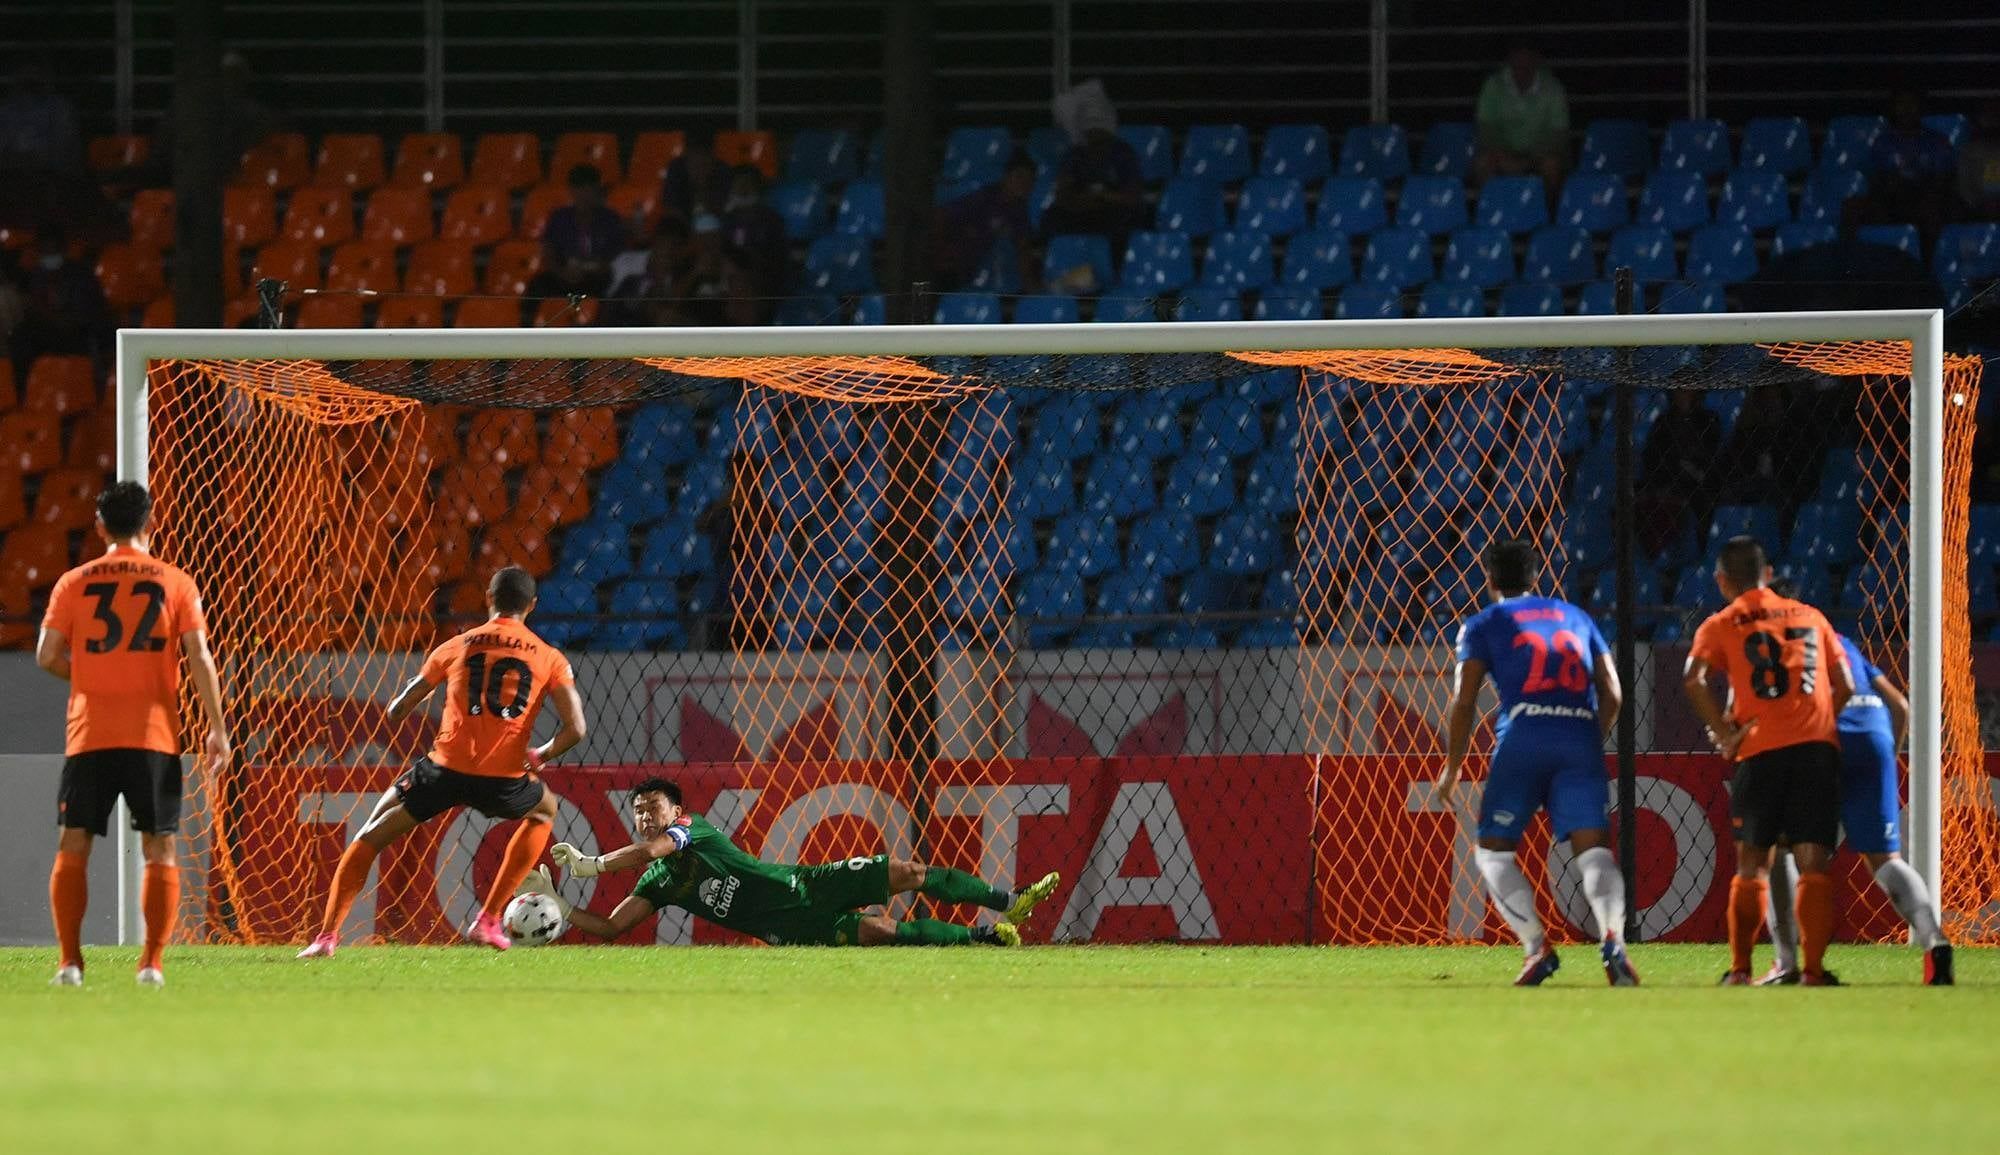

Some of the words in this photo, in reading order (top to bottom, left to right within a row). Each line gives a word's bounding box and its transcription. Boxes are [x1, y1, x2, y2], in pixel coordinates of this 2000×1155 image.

[83, 581, 168, 654] 32
[467, 652, 533, 718] 10
[1512, 629, 1588, 694] 28
[1744, 627, 1817, 699] 87
[298, 782, 1221, 945] TOYOTA
[713, 875, 741, 918] Chang
